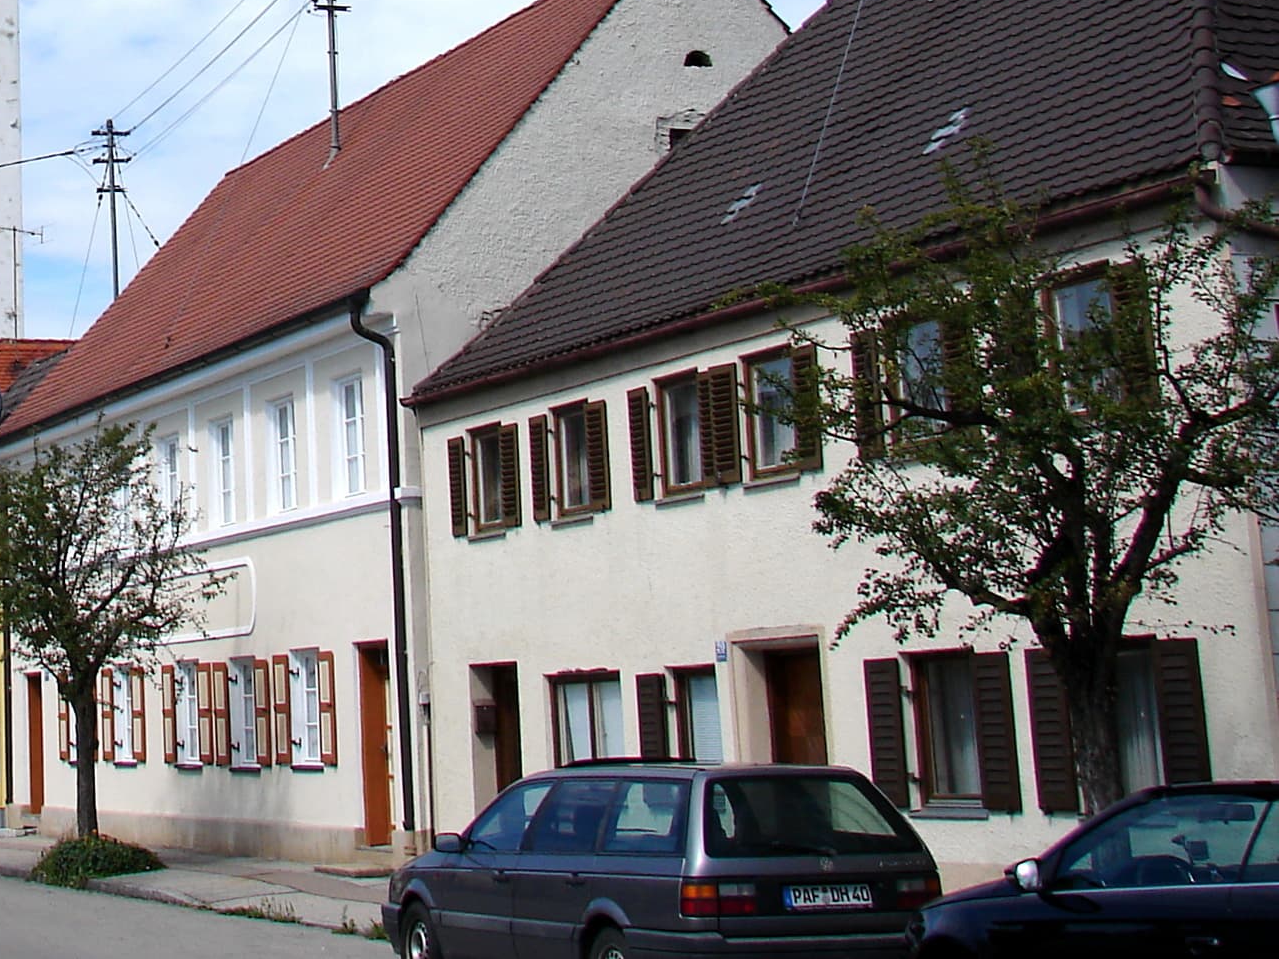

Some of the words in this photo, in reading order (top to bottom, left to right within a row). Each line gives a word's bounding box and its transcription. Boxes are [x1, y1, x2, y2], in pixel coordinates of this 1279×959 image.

[793, 888, 819, 904] PAF
[831, 887, 851, 903] DH
[852, 886, 870, 902] 40
